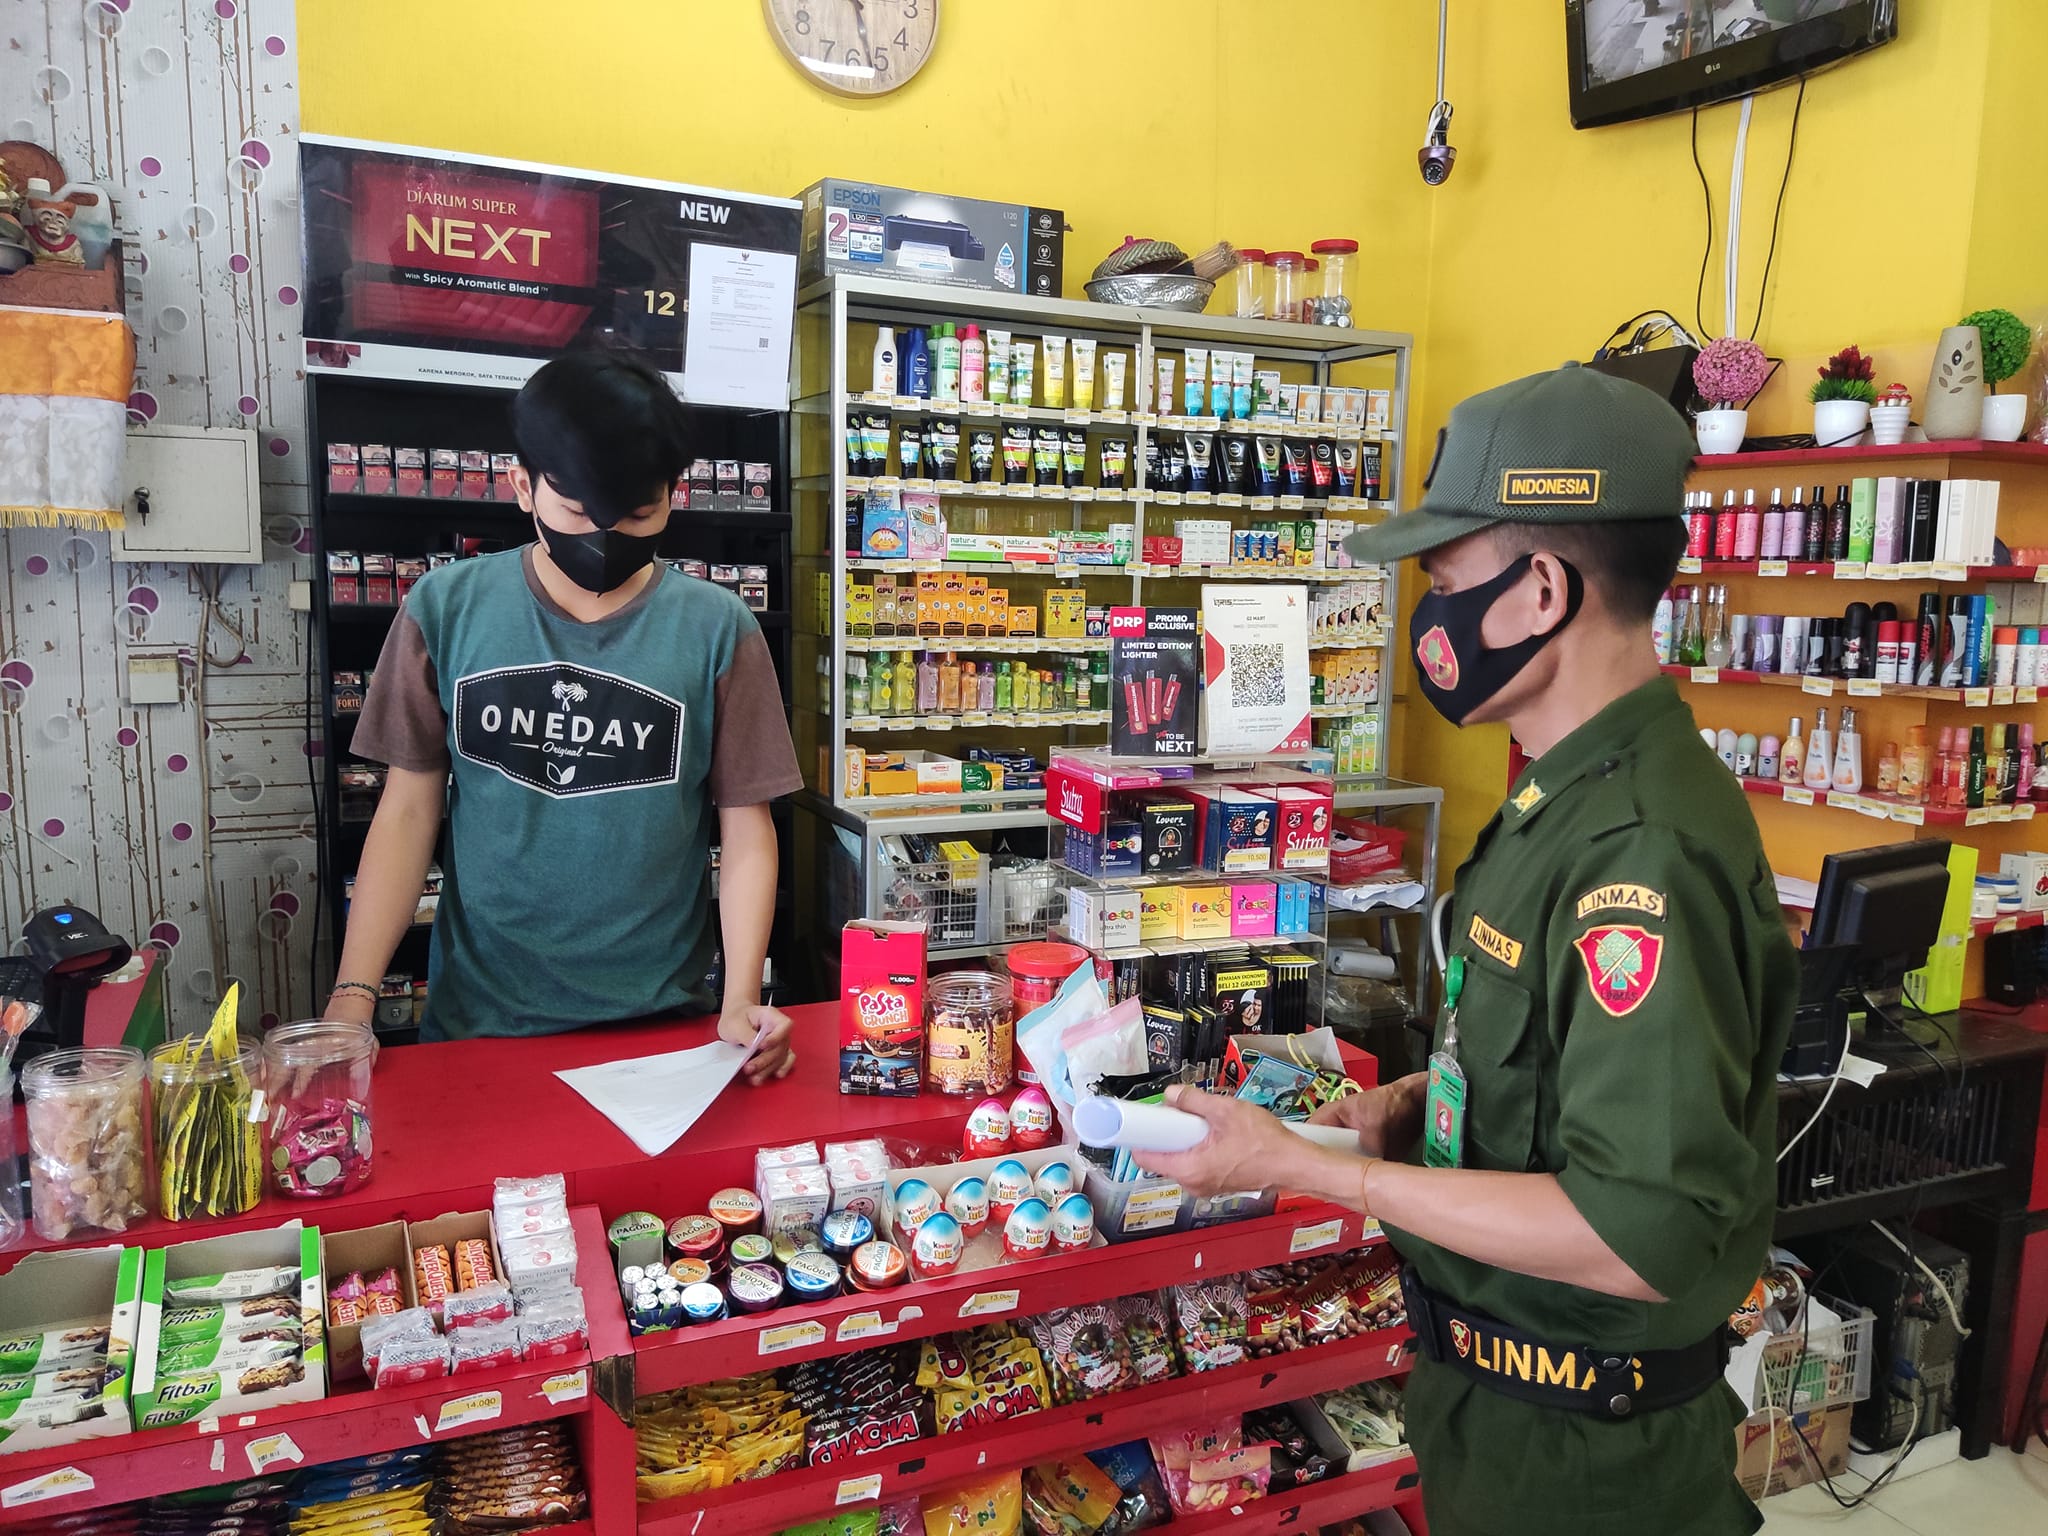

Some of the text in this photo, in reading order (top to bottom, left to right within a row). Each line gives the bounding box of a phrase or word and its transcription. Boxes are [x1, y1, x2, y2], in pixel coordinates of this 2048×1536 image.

[795, 10, 811, 36] 8
[893, 27, 909, 51] 4
[819, 39, 836, 62] 7
[845, 48, 862, 67] 6
[874, 47, 889, 72] 5
[834, 188, 880, 206] EPSON
[472, 198, 518, 216] SUPER
[680, 200, 730, 225] NEW
[828, 212, 848, 243] 2
[406, 214, 551, 267] NEXT
[405, 272, 540, 294] With Spicy Aromatic Blend
[644, 290, 676, 316] 12
[400, 472, 423, 480] NEXT
[432, 472, 457, 480] NEXT
[1512, 477, 1590, 496] INDONESIA
[950, 536, 977, 544] natur-e
[876, 586, 893, 594] GPU
[922, 581, 938, 589] GPU
[946, 581, 962, 589] GPU
[1113, 616, 1144, 628] DRP
[1148, 622, 1195, 630] EXCLUSIVE
[1155, 614, 1188, 622] PROMO
[1158, 642, 1192, 650] EDITION
[1122, 651, 1158, 660] LIGHTER
[337, 700, 362, 709] FORTE
[480, 704, 654, 750] ONEDAY
[542, 741, 585, 758] Original
[1155, 740, 1194, 752] NEXT
[852, 763, 860, 787] CDR
[1060, 779, 1084, 816] Sutra
[1156, 816, 1184, 824] Lovers
[1286, 831, 1325, 850] Sutra
[1140, 902, 1173, 914] fiesta
[1192, 902, 1226, 913] fiesta
[1238, 900, 1270, 911] fiesta
[1580, 888, 1659, 914] LINMAS
[1099, 910, 1134, 922] fiesta
[1473, 920, 1514, 961] LINMAS
[863, 1008, 908, 1028] CRUNCH
[1146, 1018, 1173, 1032] Lovers
[850, 1075, 869, 1083] FREE
[999, 1182, 1019, 1192] kinder
[1159, 1189, 1178, 1198] 9.000
[716, 1200, 754, 1208] PAGODA
[616, 1222, 657, 1235] PAGODA
[676, 1222, 713, 1240] PAGODA
[1026, 1227, 1044, 1235] kinder
[933, 1242, 953, 1250] kinder
[874, 1245, 886, 1272] PAGODA
[420, 1246, 446, 1301] SILVERQUEEN
[794, 1260, 832, 1278] PAGODA
[738, 1271, 774, 1292] PAGODA
[165, 1311, 219, 1328] Fitbar
[157, 1381, 216, 1404] Fitbar
[143, 1408, 192, 1426] Fitbar
[809, 1411, 920, 1467] CHACHA
